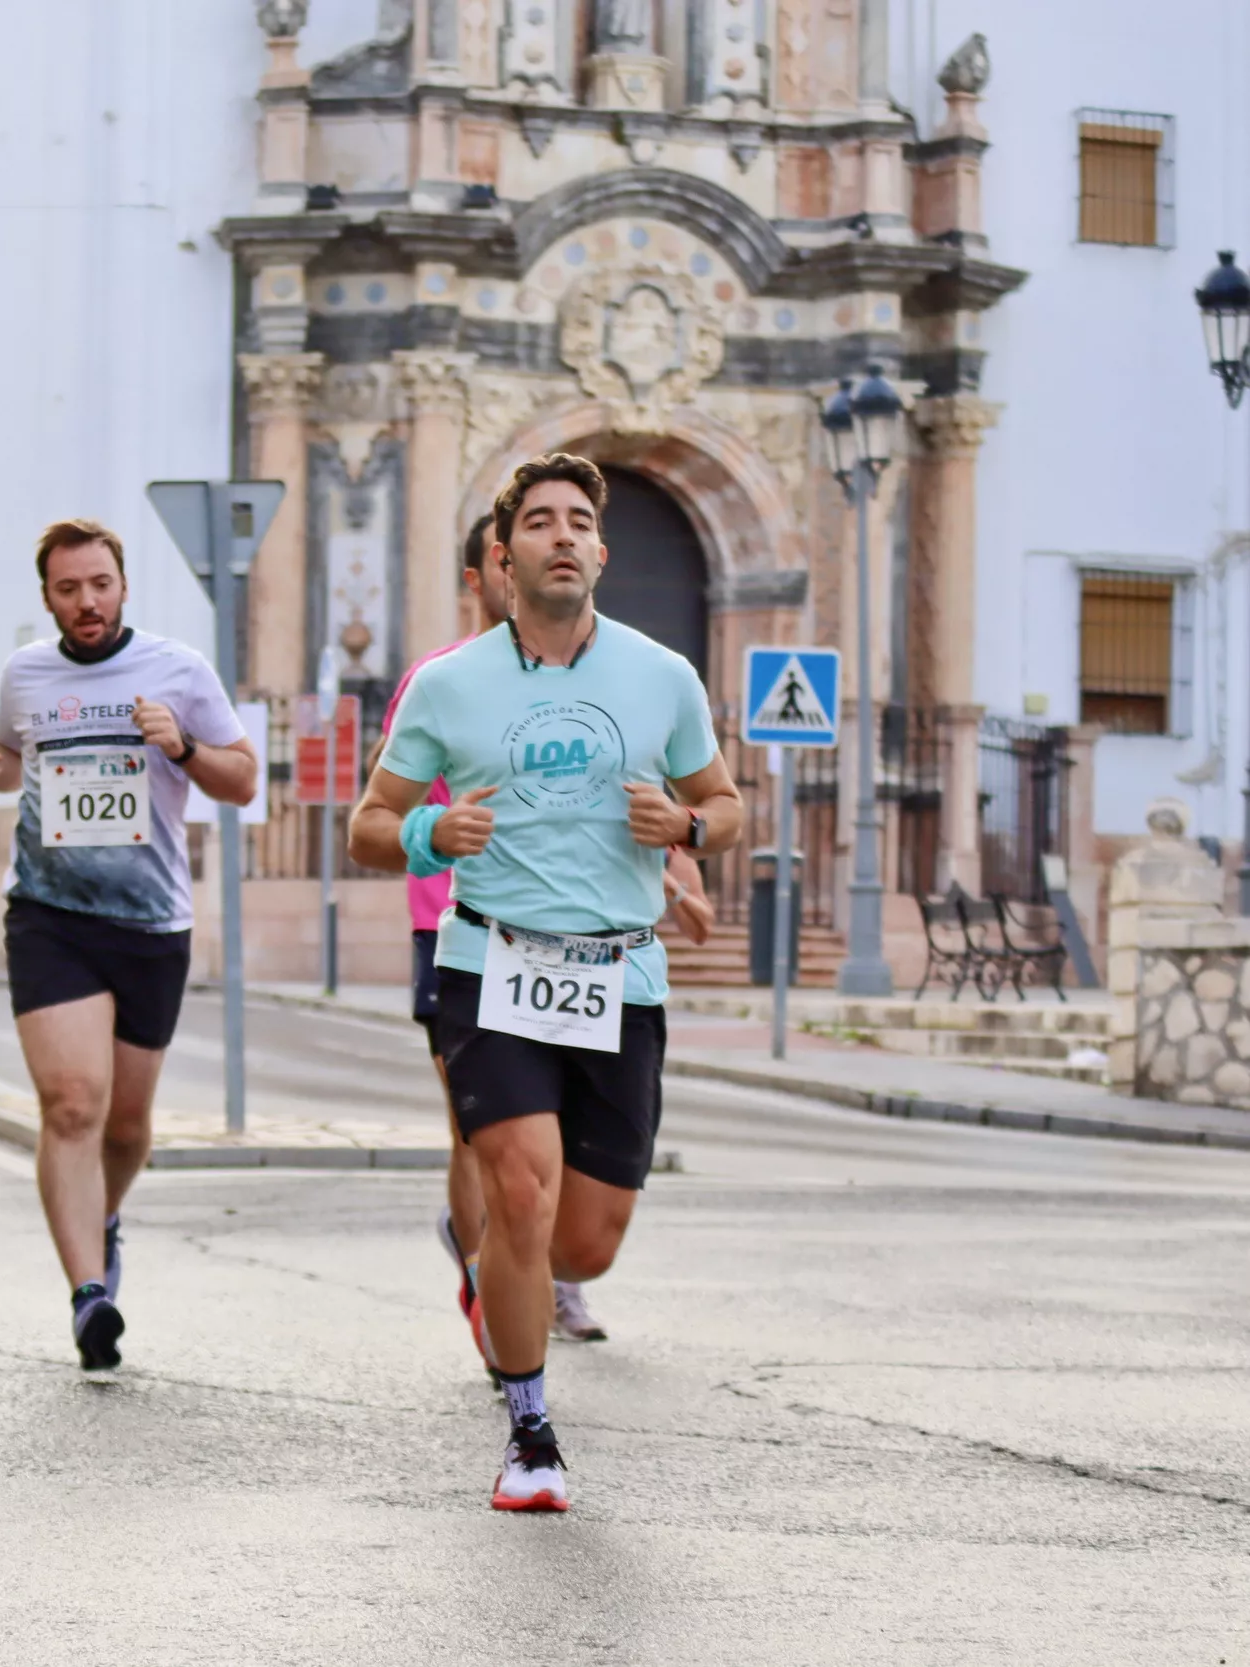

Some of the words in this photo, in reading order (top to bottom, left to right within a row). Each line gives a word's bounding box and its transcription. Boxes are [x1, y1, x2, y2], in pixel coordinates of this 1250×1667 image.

[31, 713, 44, 726] EL
[523, 738, 588, 771] LOA
[58, 792, 137, 821] 1020
[506, 973, 607, 1019] 1025
